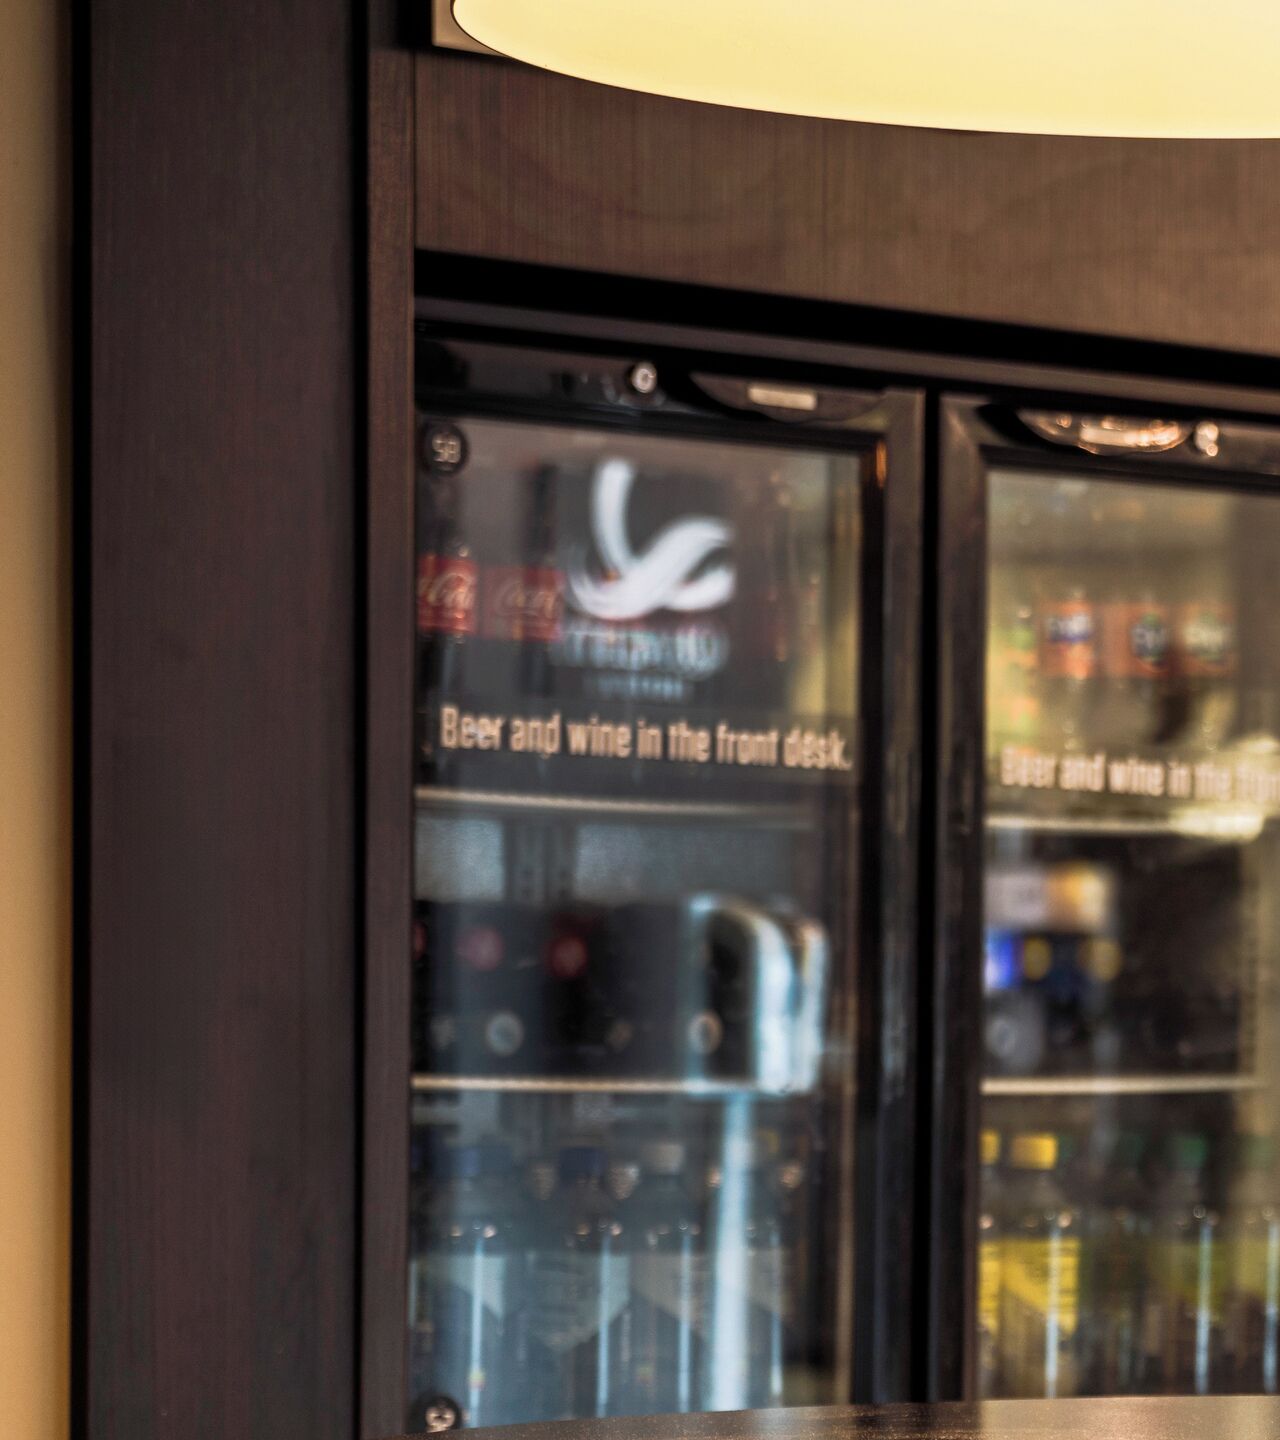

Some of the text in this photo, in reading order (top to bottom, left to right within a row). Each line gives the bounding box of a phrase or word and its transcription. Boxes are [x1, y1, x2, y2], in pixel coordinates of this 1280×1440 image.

[440, 704, 504, 749] Beer
[510, 711, 560, 754] and
[566, 713, 631, 758] wine
[637, 719, 662, 760] in
[669, 720, 710, 763] the
[716, 719, 778, 766] front
[1001, 747, 1055, 788] Beer
[1059, 753, 1106, 791] and
[1108, 758, 1164, 796] wine
[1167, 762, 1190, 798] in
